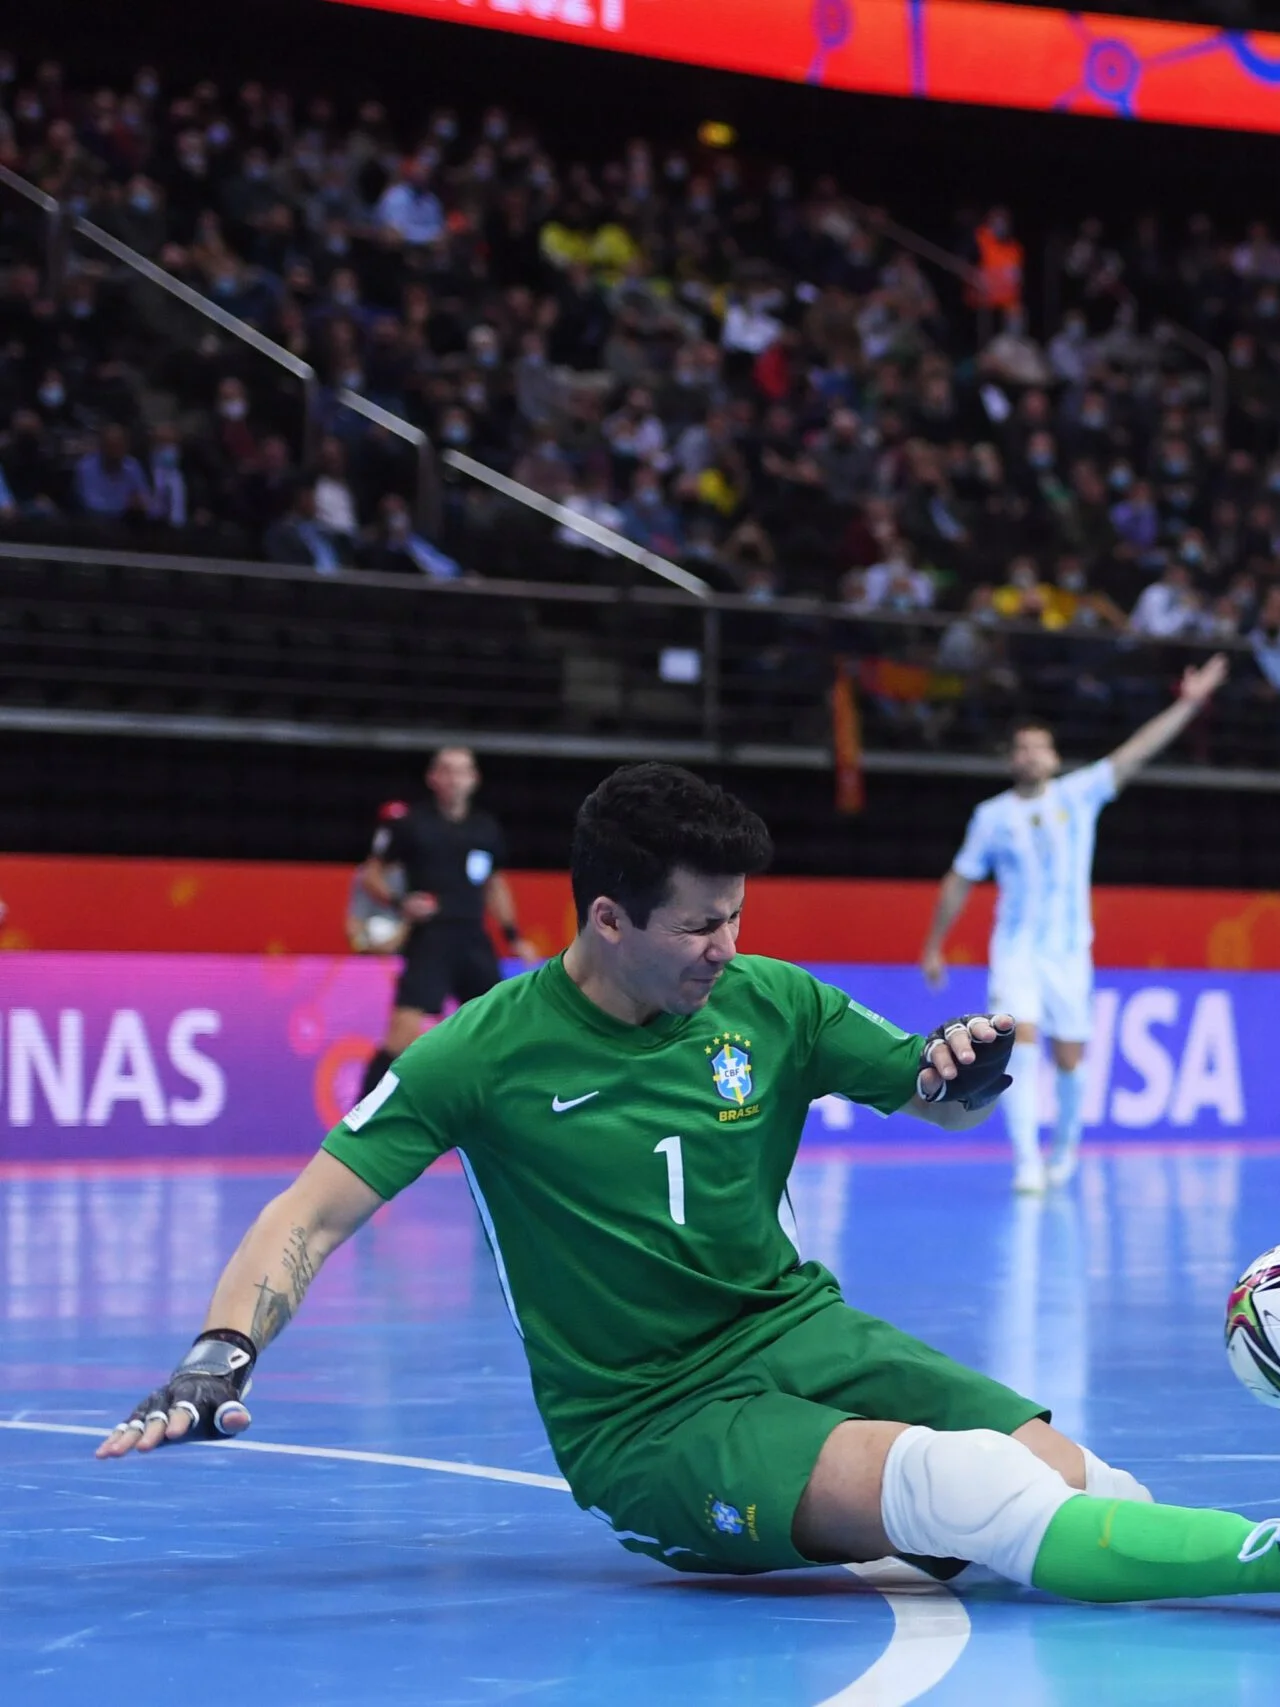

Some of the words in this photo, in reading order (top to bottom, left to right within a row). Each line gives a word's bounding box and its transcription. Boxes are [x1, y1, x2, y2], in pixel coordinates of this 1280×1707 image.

[0, 1007, 227, 1128] NAS
[724, 1067, 741, 1078] CBF
[1036, 986, 1246, 1127] ISA
[718, 1104, 761, 1123] BRASIL
[653, 1135, 686, 1225] 1
